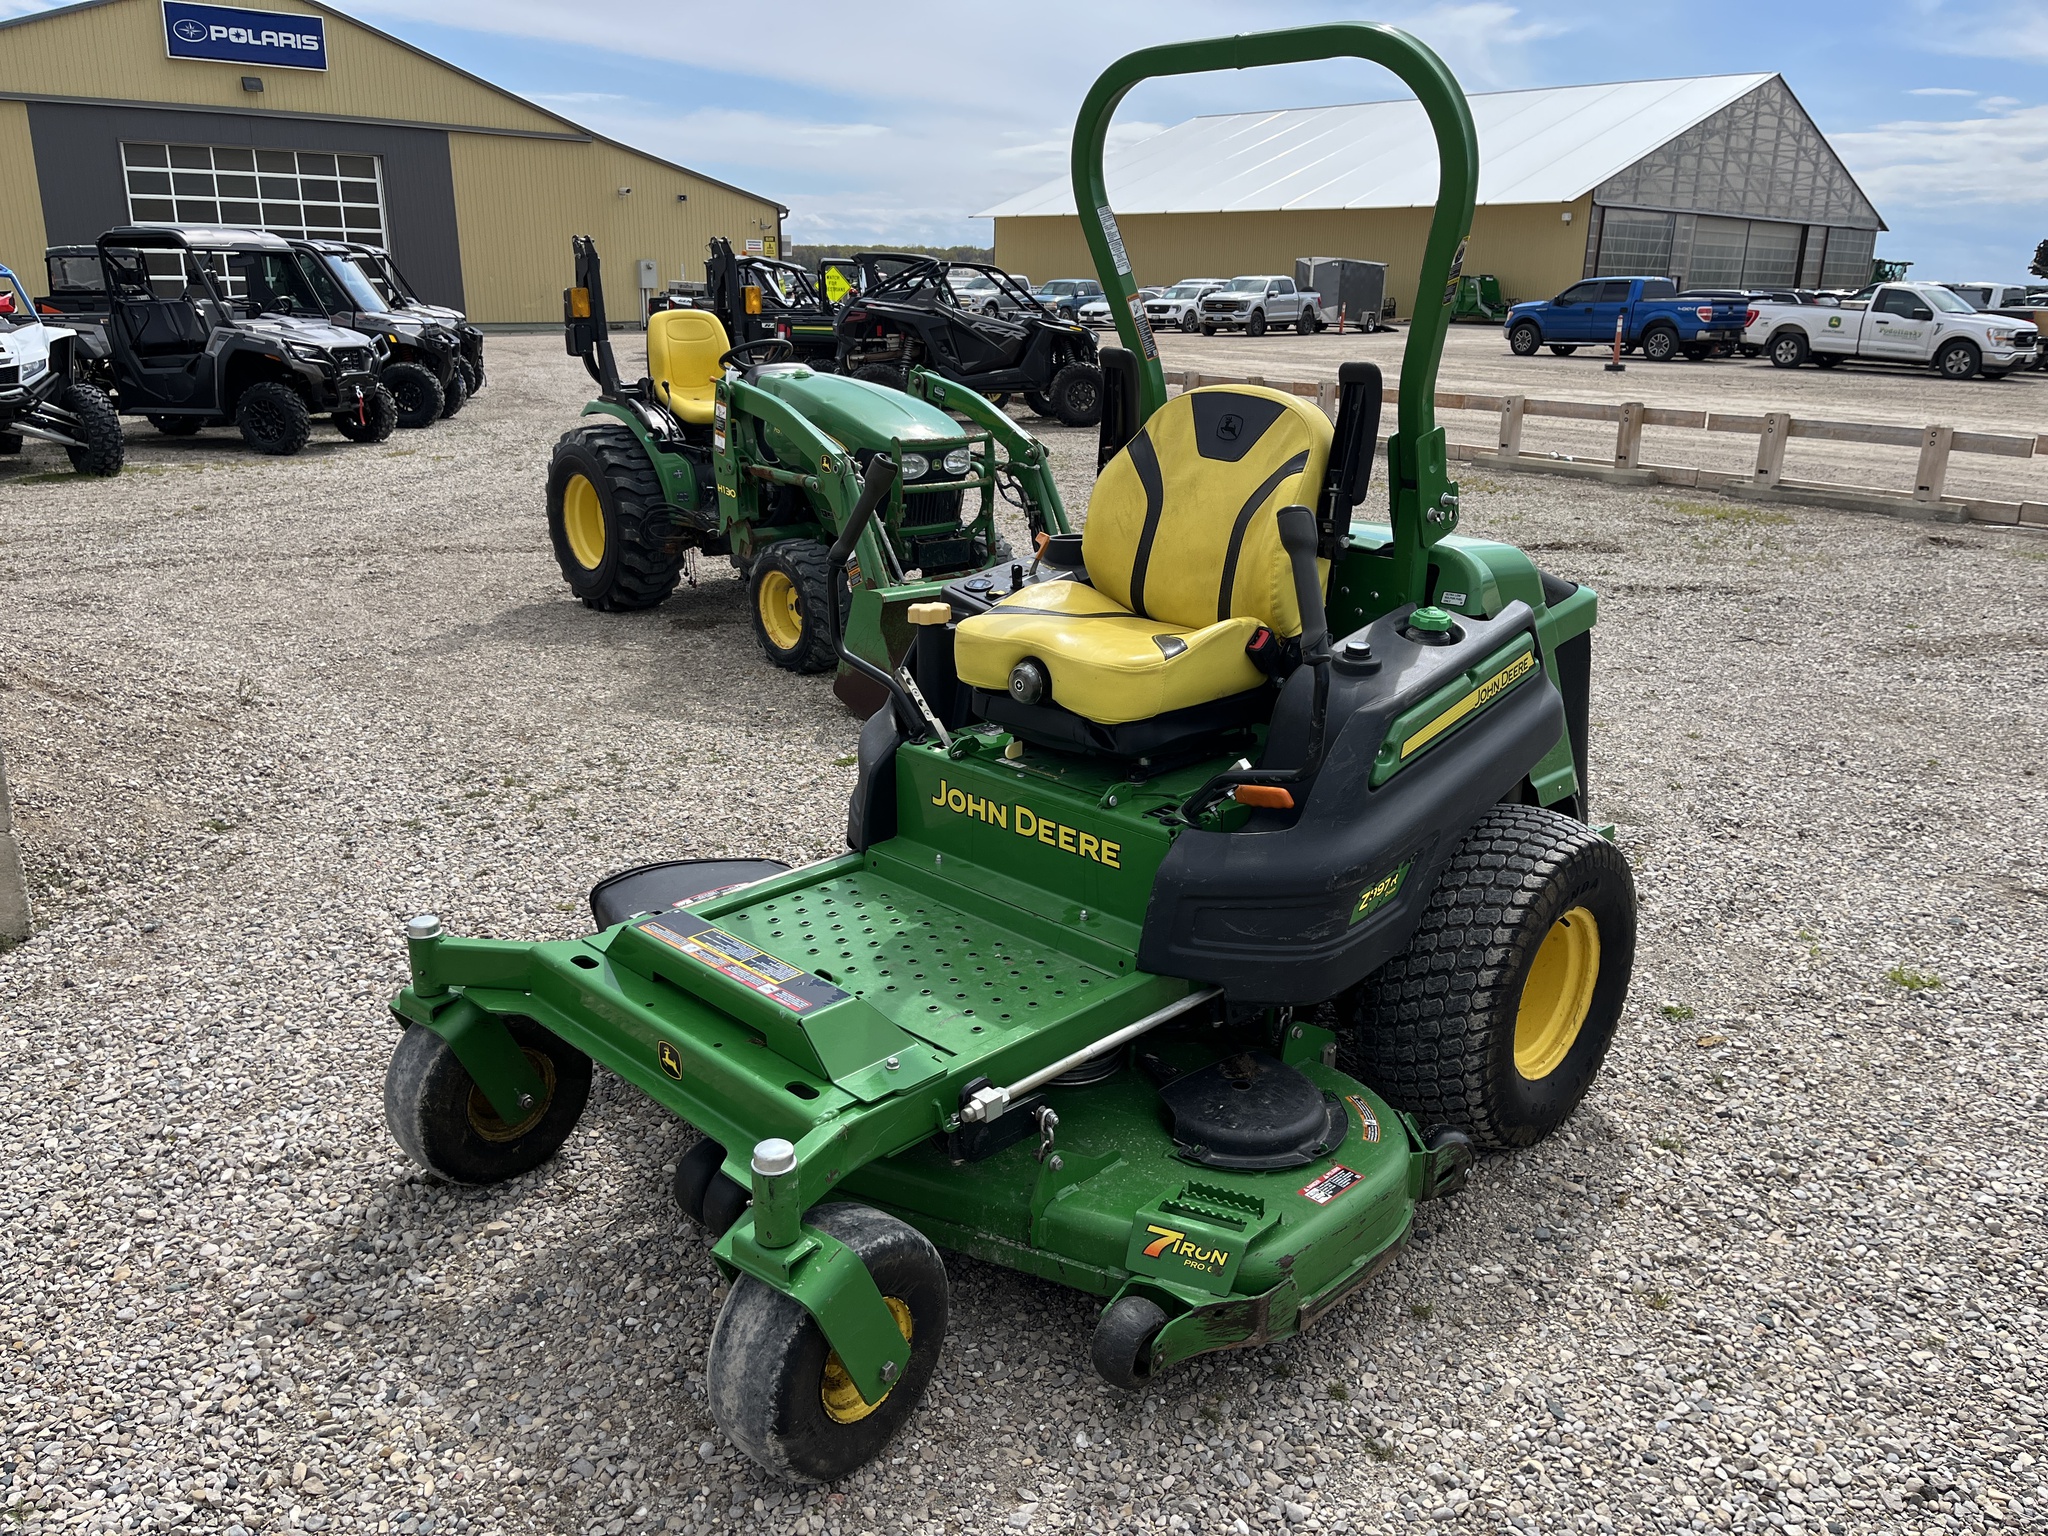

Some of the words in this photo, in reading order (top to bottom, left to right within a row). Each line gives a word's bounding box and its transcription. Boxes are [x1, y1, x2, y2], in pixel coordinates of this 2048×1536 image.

[209, 25, 319, 51] POLARIS
[970, 321, 1027, 341] RZR
[717, 483, 737, 499] H130
[1475, 680, 1500, 707] JOHN
[1501, 657, 1529, 686] DEERE
[931, 778, 1008, 830] JOHN
[1014, 803, 1122, 870] DEERE
[1183, 1259, 1206, 1271] PRO
